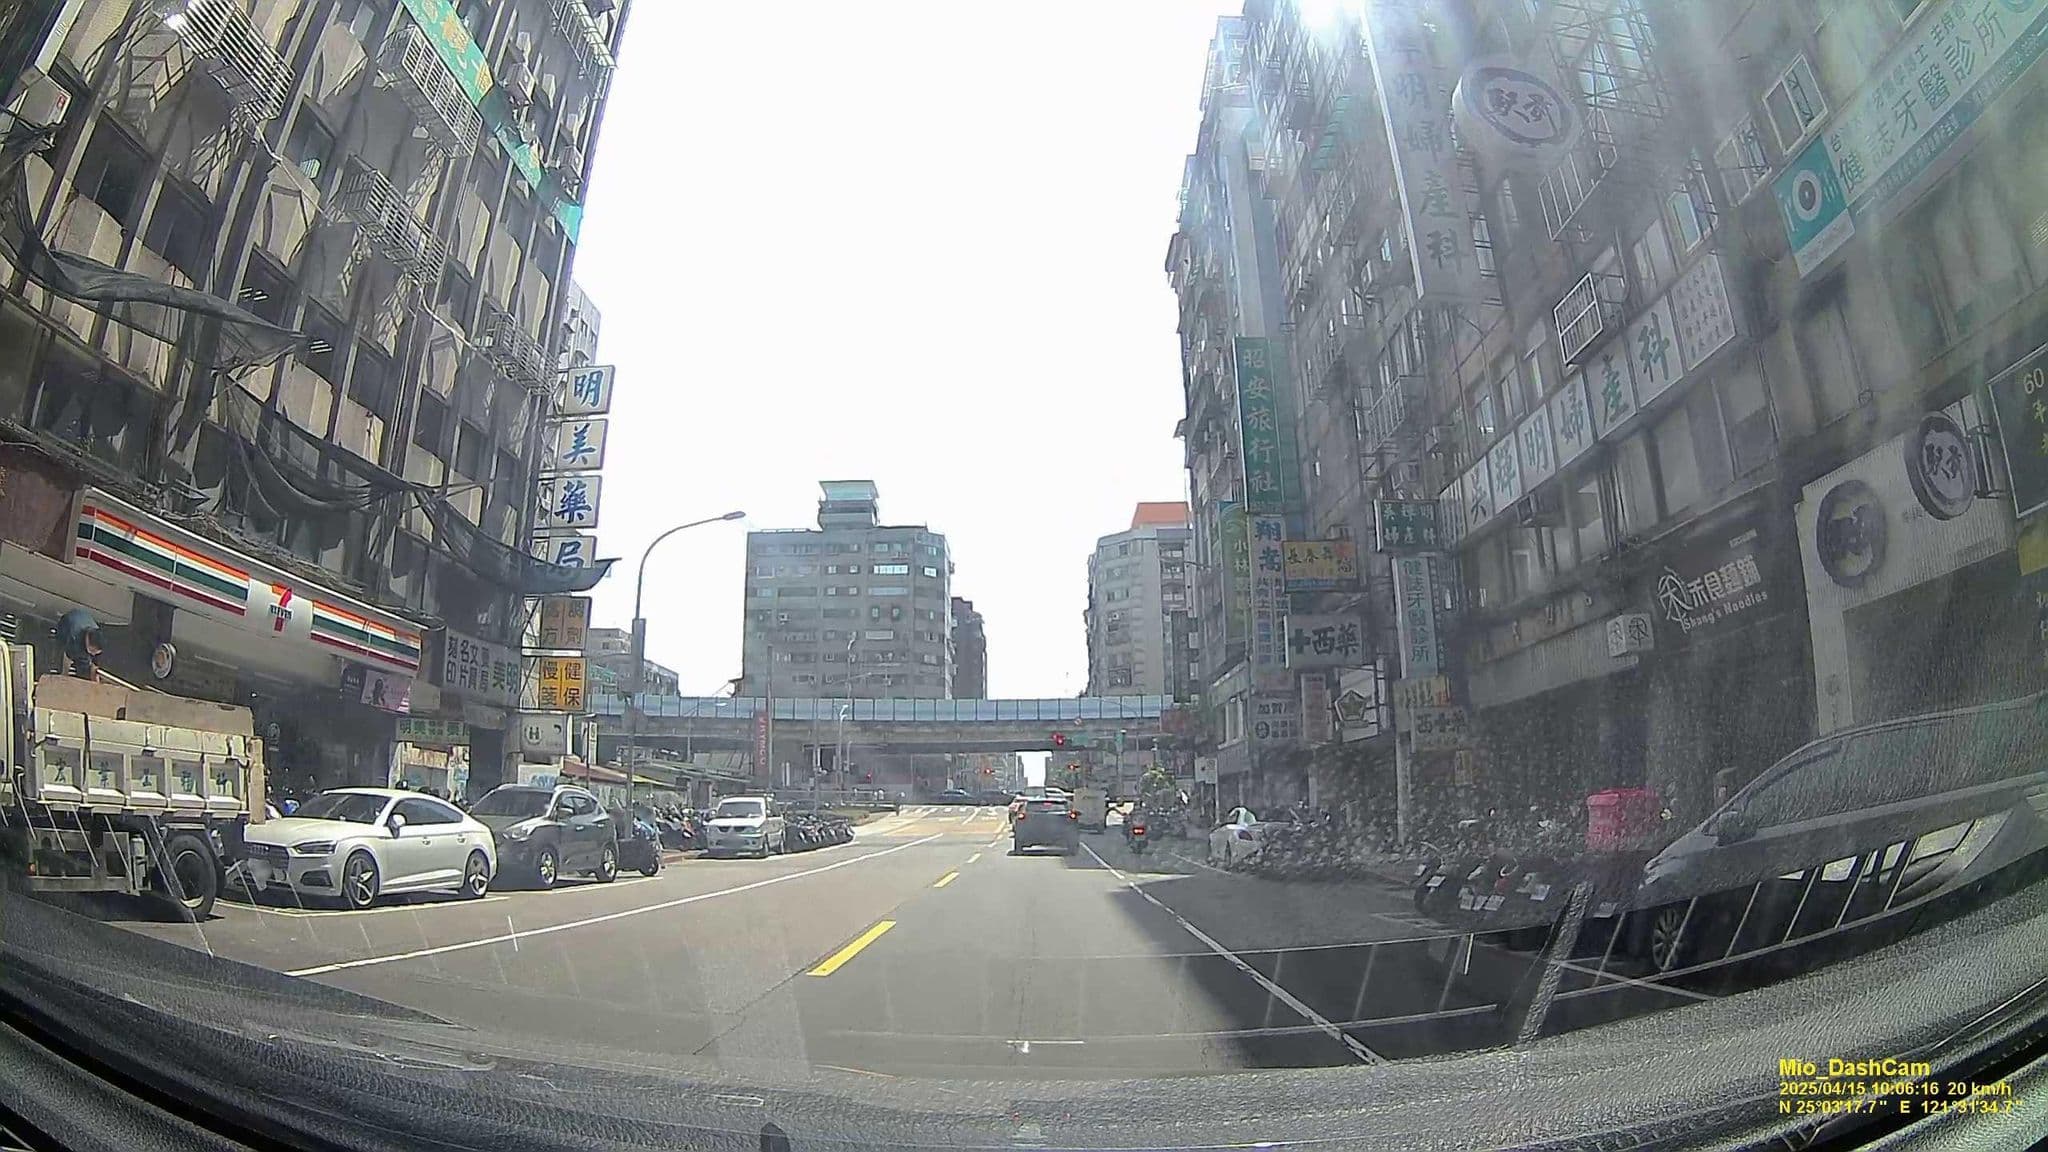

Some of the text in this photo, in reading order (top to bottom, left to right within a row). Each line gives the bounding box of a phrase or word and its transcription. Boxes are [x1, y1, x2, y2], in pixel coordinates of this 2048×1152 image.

[2023, 367, 2045, 394] 60
[1243, 348, 1279, 494] 昭安旅行社
[1723, 591, 1769, 616] Noodles
[1311, 623, 1358, 655] 西藥
[563, 662, 582, 706] 健保
